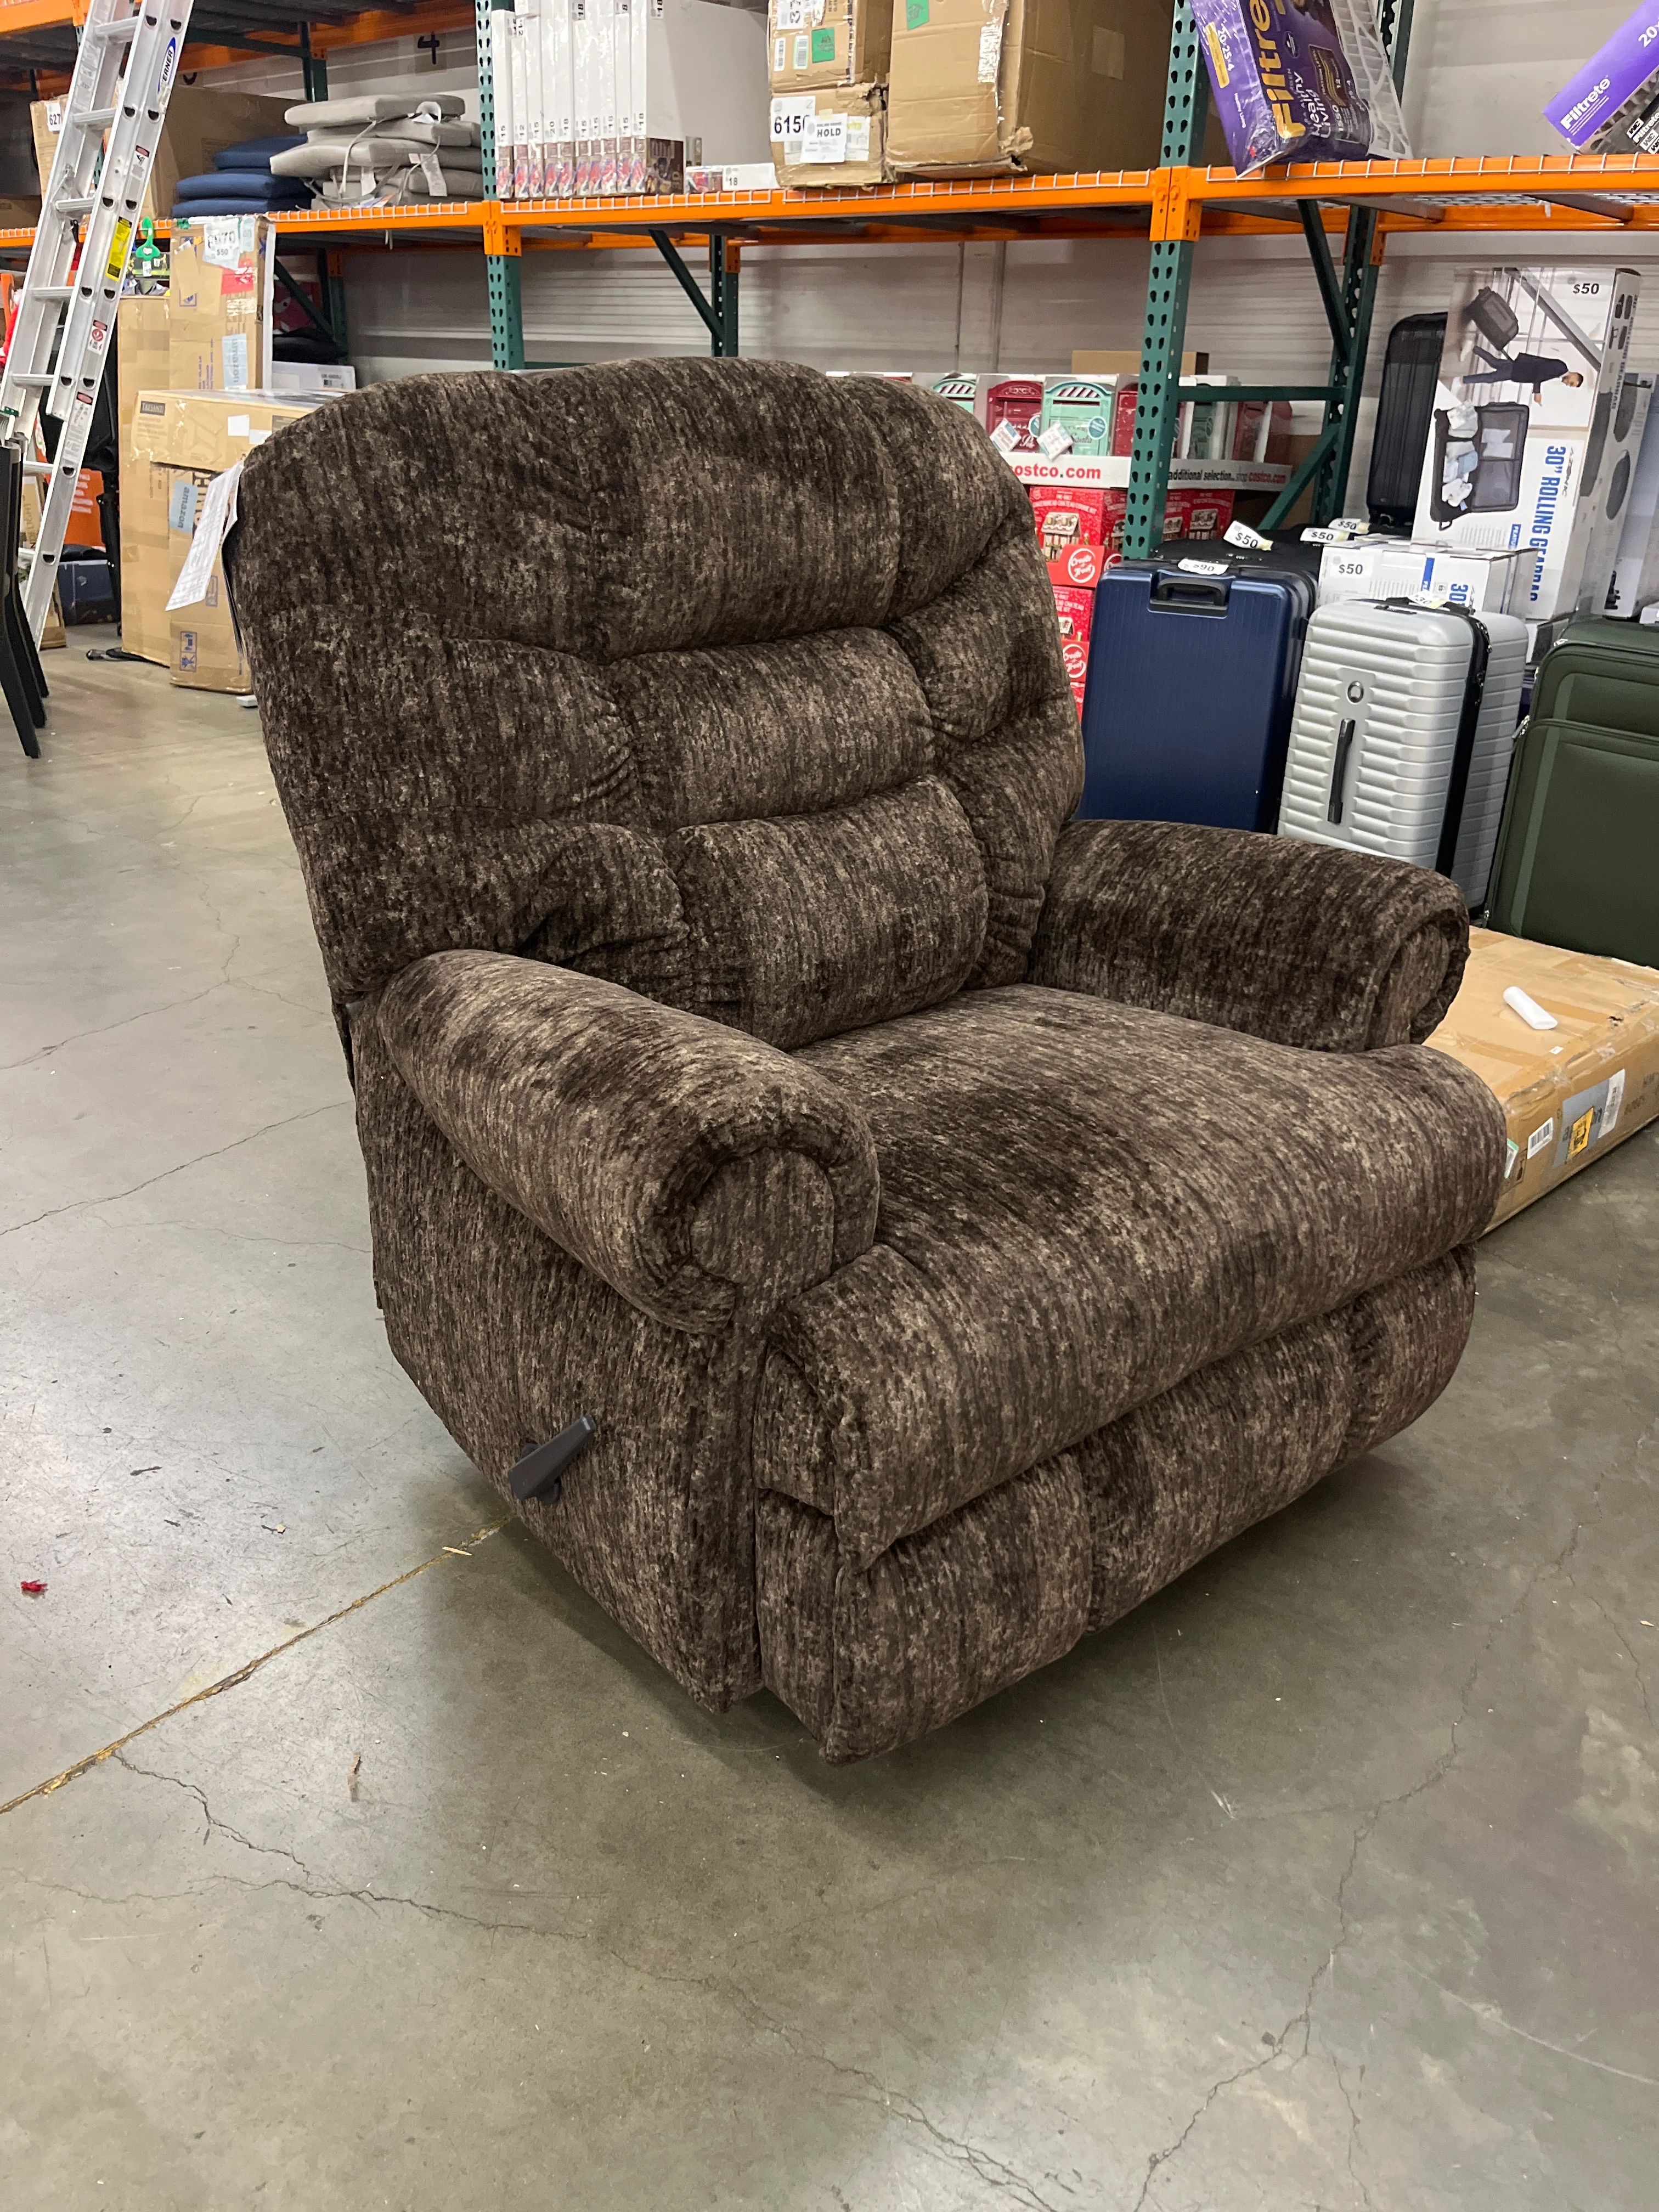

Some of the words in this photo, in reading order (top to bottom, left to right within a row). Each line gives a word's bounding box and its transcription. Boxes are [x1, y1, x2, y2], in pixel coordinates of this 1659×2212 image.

[161, 49, 173, 87] ERNER
[1294, 71, 1323, 137] Healthy
[1560, 78, 1611, 130] Filtrete
[1306, 89, 1331, 138] Living
[816, 127, 842, 138] HOLD
[1572, 283, 1600, 295] $50
[1009, 464, 1101, 479] ostco.com
[177, 487, 190, 528] amazon
[1531, 476, 1561, 535] ROLLING
[1337, 520, 1357, 532] $50
[1235, 531, 1259, 549] $50
[1310, 531, 1334, 541] $50
[1339, 563, 1363, 575] $50
